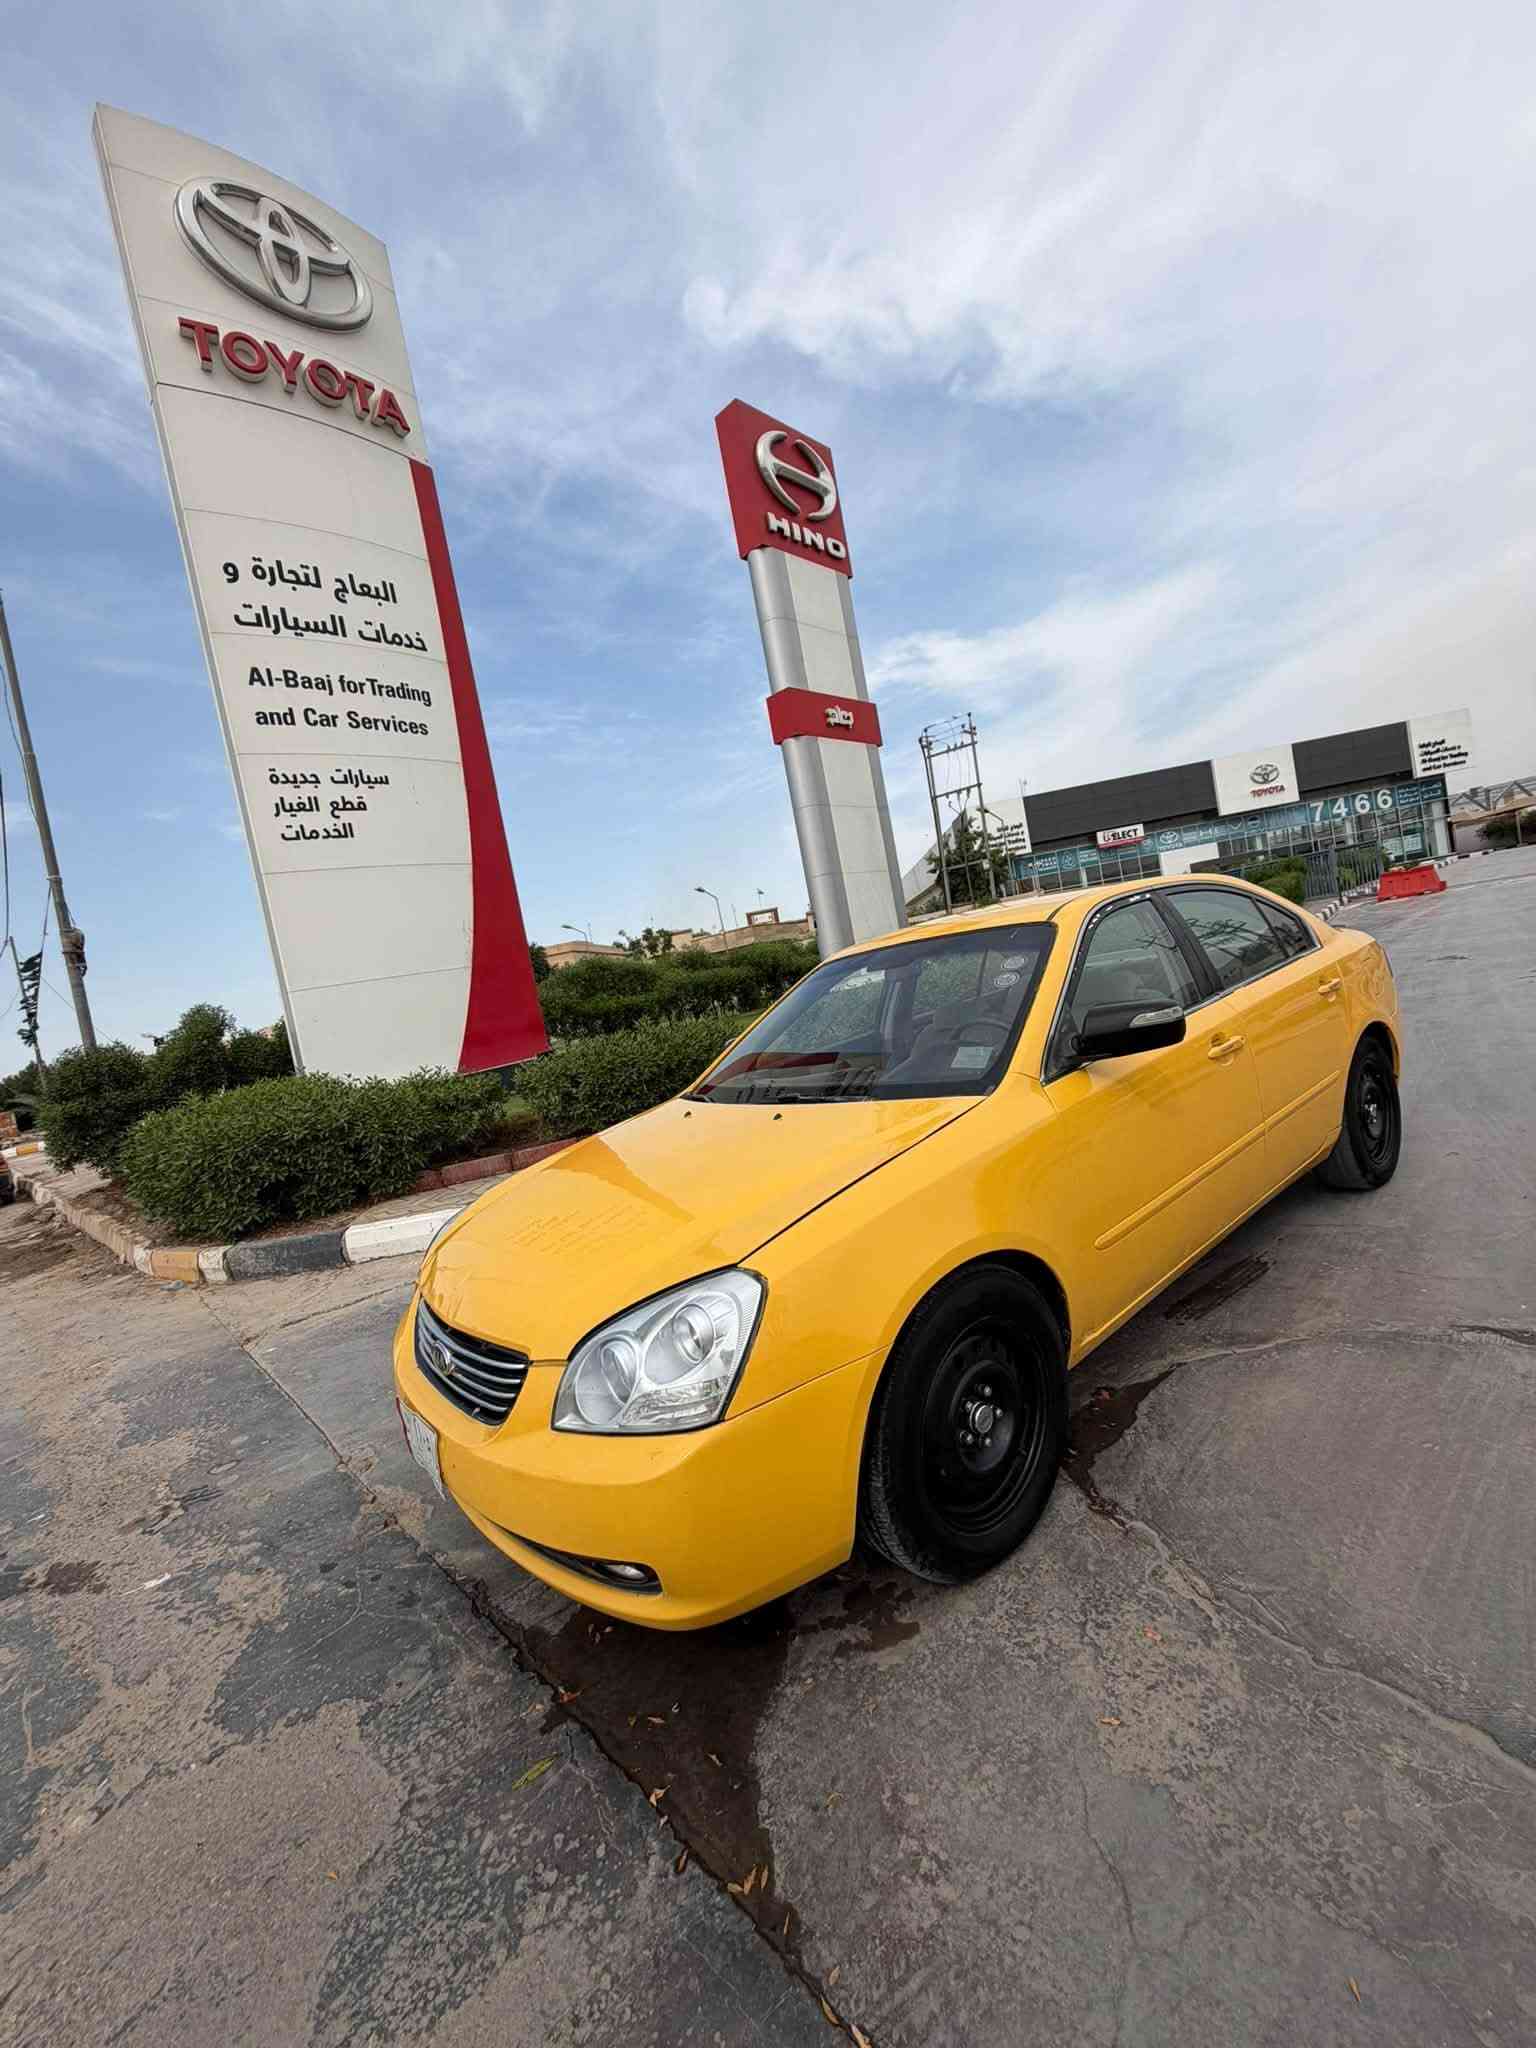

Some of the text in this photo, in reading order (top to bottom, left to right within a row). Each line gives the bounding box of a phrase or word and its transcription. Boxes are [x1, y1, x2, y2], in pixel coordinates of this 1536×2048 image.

[178, 316, 411, 438] TOYOTA
[767, 511, 848, 560] HINO
[222, 556, 397, 606] البعاج لتجارة و
[233, 603, 428, 651] خدمات السيارات
[249, 666, 433, 707] Al-Baaj for Trading
[255, 706, 430, 736] and Car Services
[268, 767, 390, 789] سيارات جديدة
[1249, 784, 1286, 799] TOYOTA
[274, 795, 368, 819] قطع الغيار
[1310, 789, 1393, 822] 7466
[281, 822, 355, 841] الخدمات
